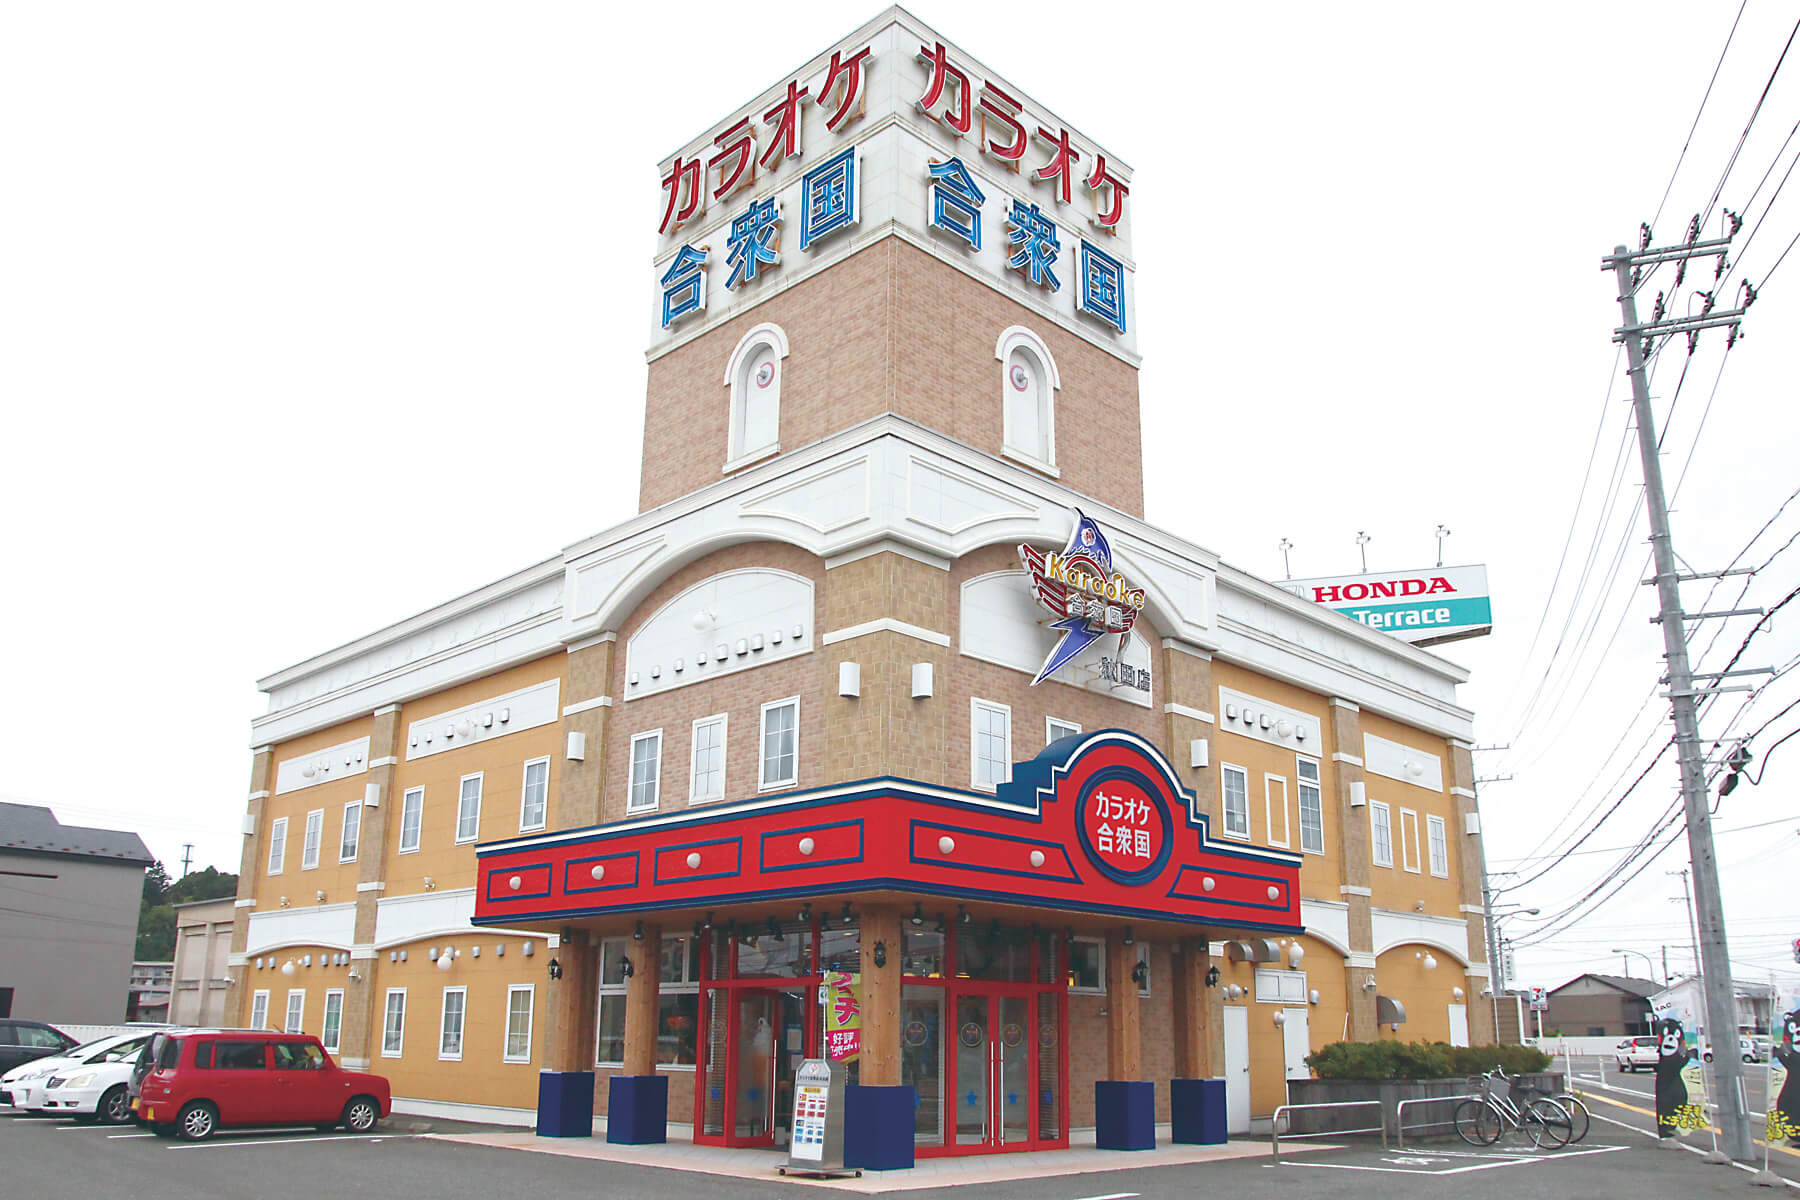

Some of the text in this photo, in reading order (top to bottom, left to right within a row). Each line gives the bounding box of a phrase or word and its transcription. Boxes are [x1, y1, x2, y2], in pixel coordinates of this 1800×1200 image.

[658, 44, 875, 235] カラオケ
[918, 42, 1131, 227] カラオケ
[660, 145, 861, 329] 合衆国
[927, 156, 1127, 335] 合衆国
[1048, 551, 1145, 610] Karaoke
[1311, 577, 1458, 603] HONDA
[1352, 607, 1450, 629] Terrace
[1095, 791, 1151, 825] カラオケ
[1096, 822, 1151, 859] 合衆国
